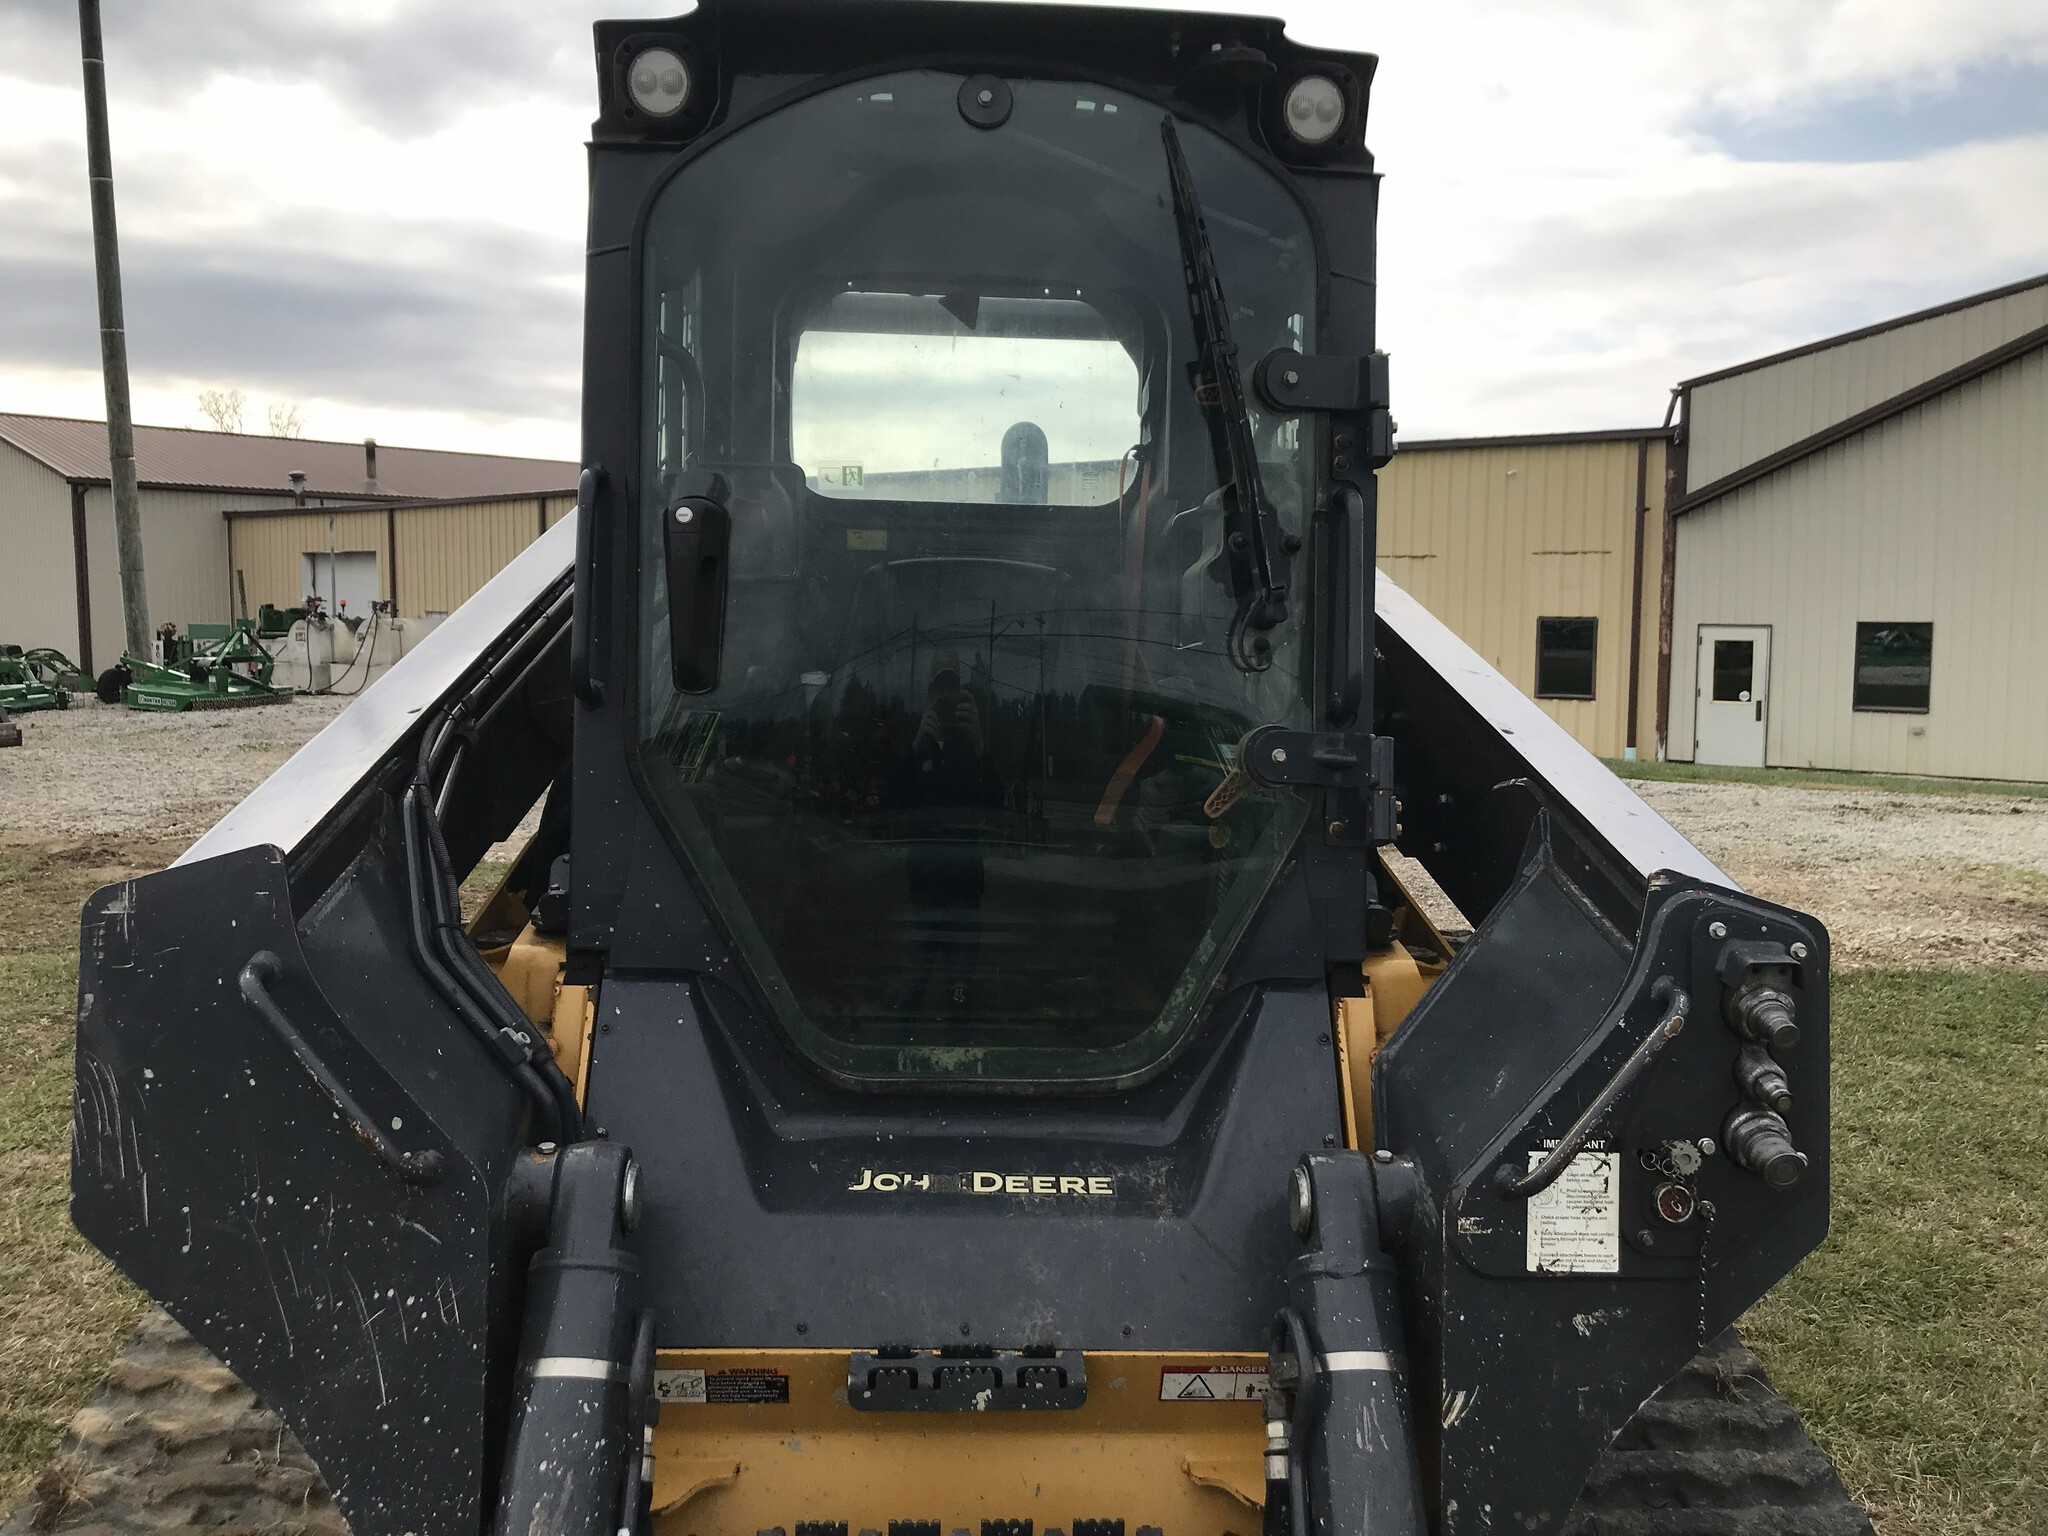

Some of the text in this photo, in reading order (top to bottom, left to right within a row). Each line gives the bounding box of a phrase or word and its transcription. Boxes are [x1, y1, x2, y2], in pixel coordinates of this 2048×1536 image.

[1543, 1138, 1606, 1149] IMPANT
[848, 1169, 1114, 1195] JOH DEERE
[1220, 1365, 1267, 1373] DANGER
